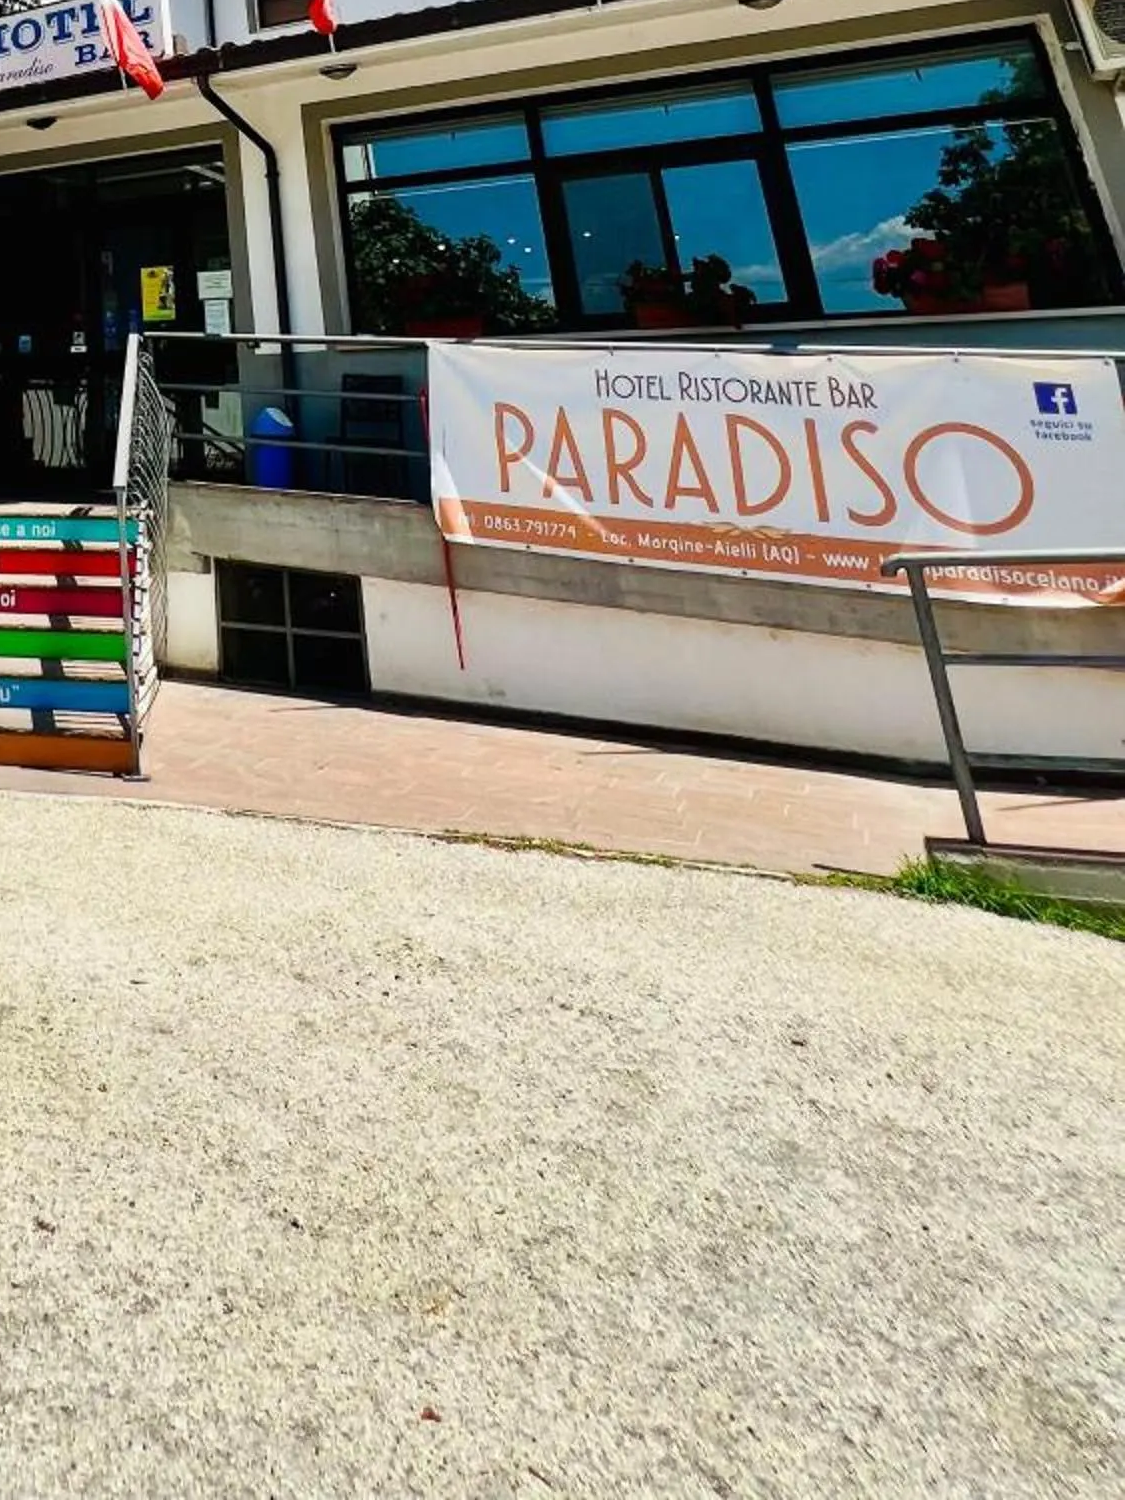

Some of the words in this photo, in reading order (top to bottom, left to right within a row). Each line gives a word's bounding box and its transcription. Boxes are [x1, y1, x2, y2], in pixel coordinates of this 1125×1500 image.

[595, 369, 671, 400] HOTEL
[678, 371, 821, 406] RISTORANTE
[828, 376, 878, 408] BAR
[1035, 431, 1092, 441] facebook
[494, 402, 1034, 536] PARADISO
[15, 523, 26, 536] a
[32, 520, 56, 537] noi
